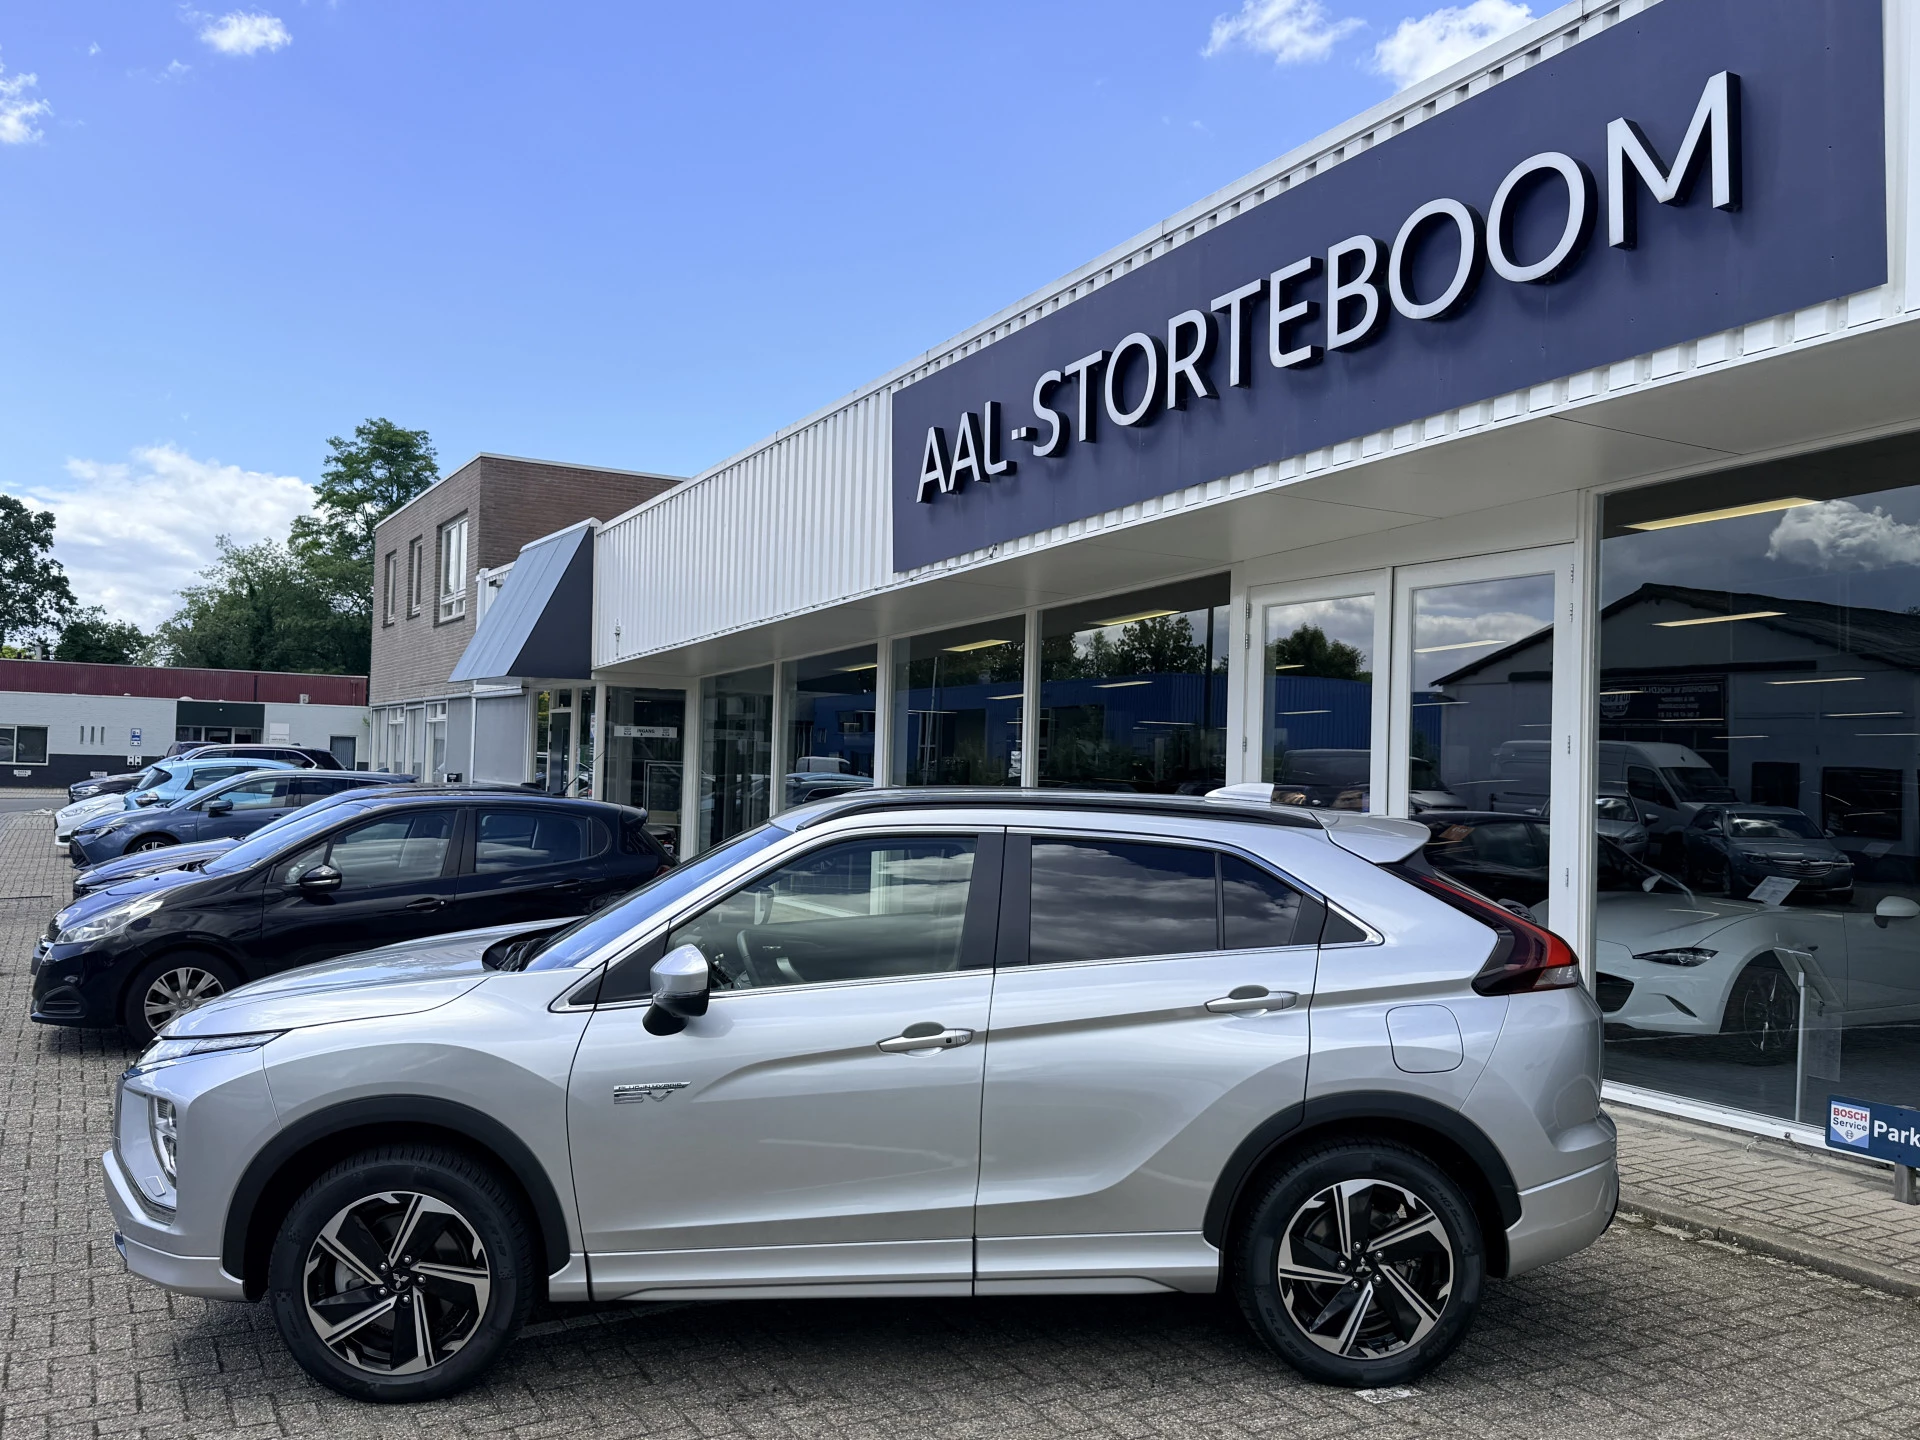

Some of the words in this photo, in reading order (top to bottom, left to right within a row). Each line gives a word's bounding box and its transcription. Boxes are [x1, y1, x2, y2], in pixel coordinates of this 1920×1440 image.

[916, 70, 1741, 504] AAL-STORTEBOOM
[1833, 1107, 1868, 1122] BOSCH
[1833, 1116, 1868, 1132] Service
